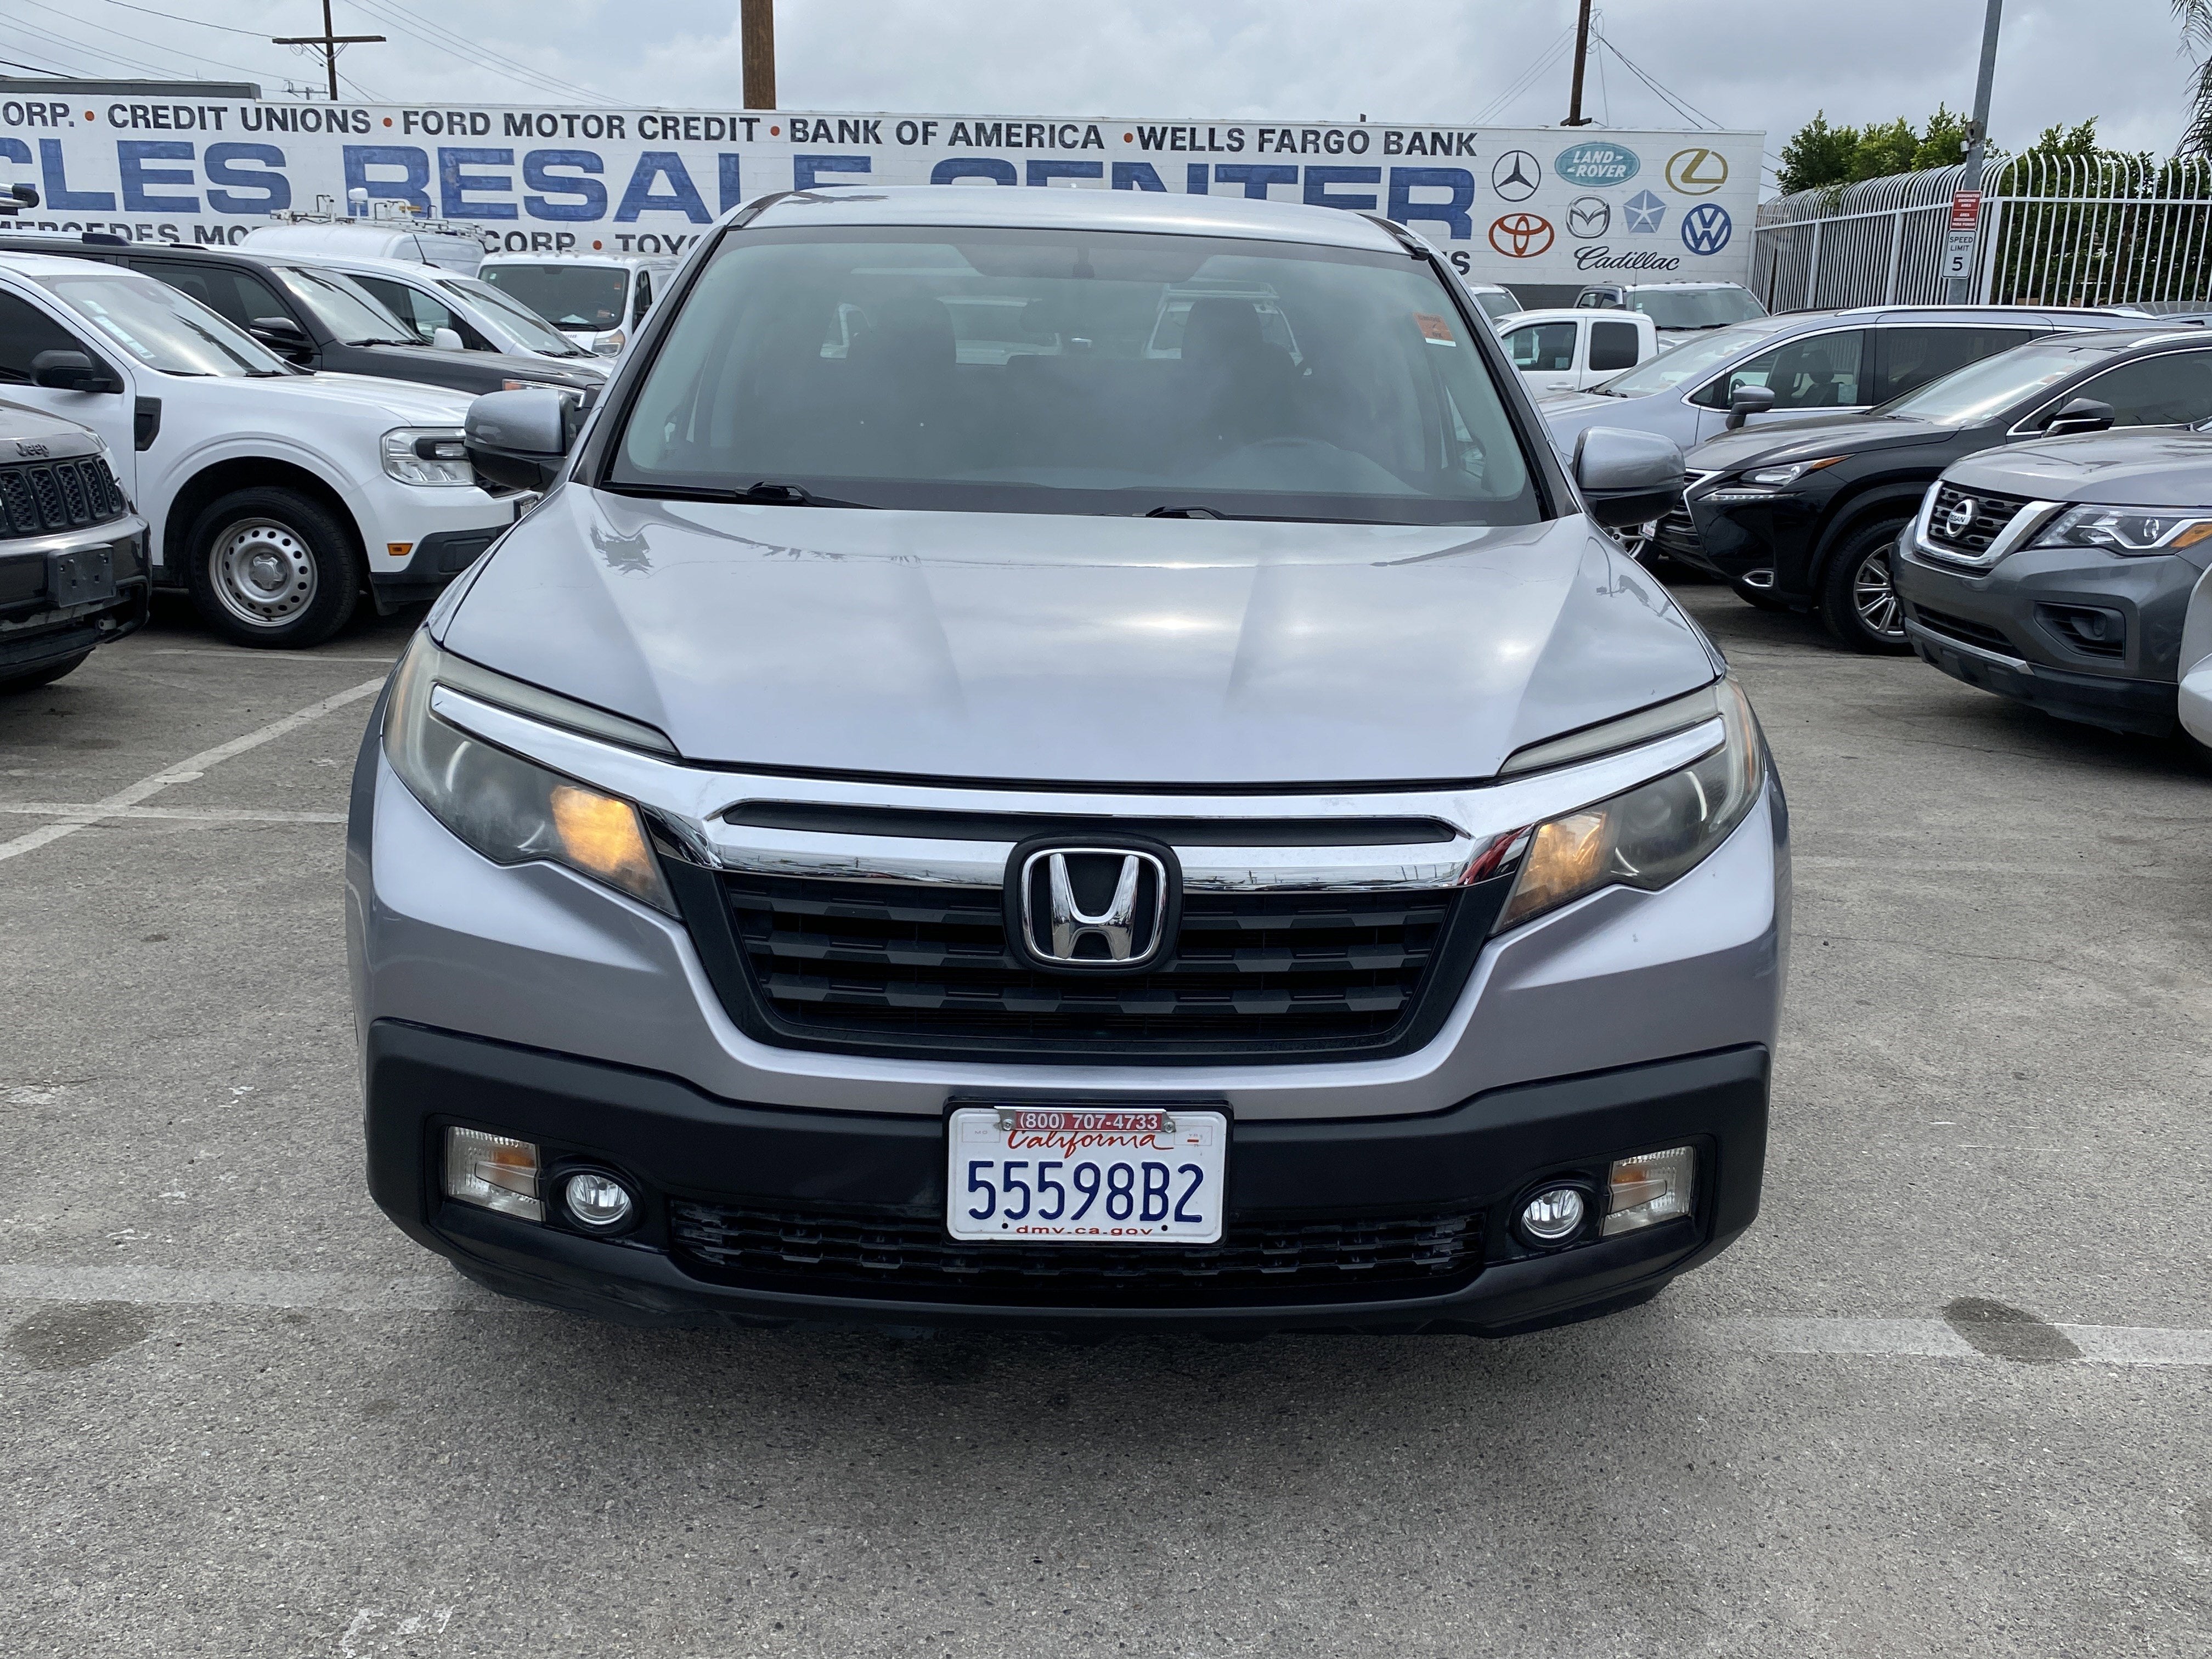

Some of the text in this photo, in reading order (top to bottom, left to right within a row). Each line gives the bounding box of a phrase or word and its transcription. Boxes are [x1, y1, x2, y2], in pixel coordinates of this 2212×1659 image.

[108, 104, 371, 133] CREDIT UNIONS
[403, 110, 760, 142] FORD MOTOR CREDIT
[789, 118, 1105, 149] BANK OF AMERICA
[1136, 126, 1477, 156] WELLS FARGO BANK
[1572, 150, 1615, 163] LAND
[1575, 165, 1627, 177] ROVER
[615, 234, 701, 255] TOY
[1573, 246, 1680, 270] Cadillac
[1951, 256, 1963, 271] 5
[16, 443, 49, 458] Jeep
[1020, 1113, 1158, 1130] (800) 707-4733
[1007, 1130, 1174, 1159] California
[968, 1160, 1204, 1222] 55598B2
[1016, 1225, 1153, 1235] dmv.ca.gov
